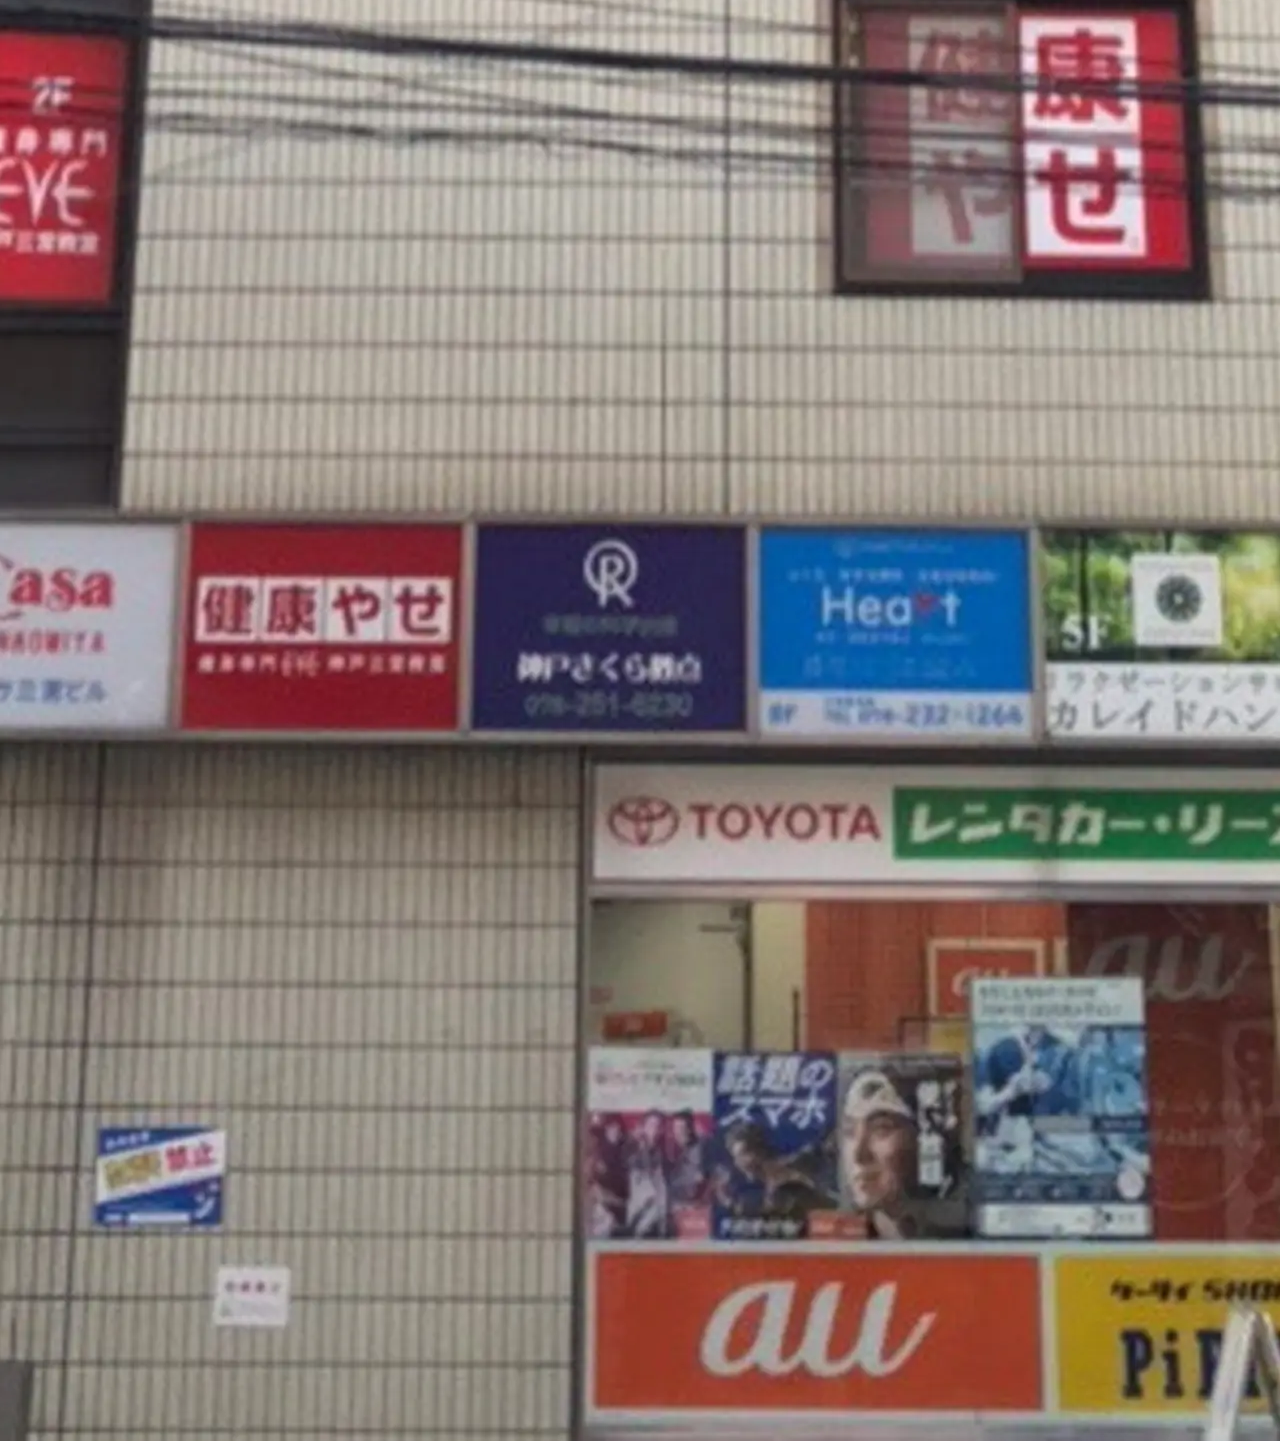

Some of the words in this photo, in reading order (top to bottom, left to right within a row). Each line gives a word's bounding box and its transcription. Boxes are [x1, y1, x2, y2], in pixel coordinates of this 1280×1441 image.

[200, 581, 446, 639] 健康やせ
[690, 803, 882, 841] TOYOTA
[717, 1055, 836, 1096] 話題の
[720, 1094, 829, 1131] スマホ
[699, 1279, 938, 1377] au
